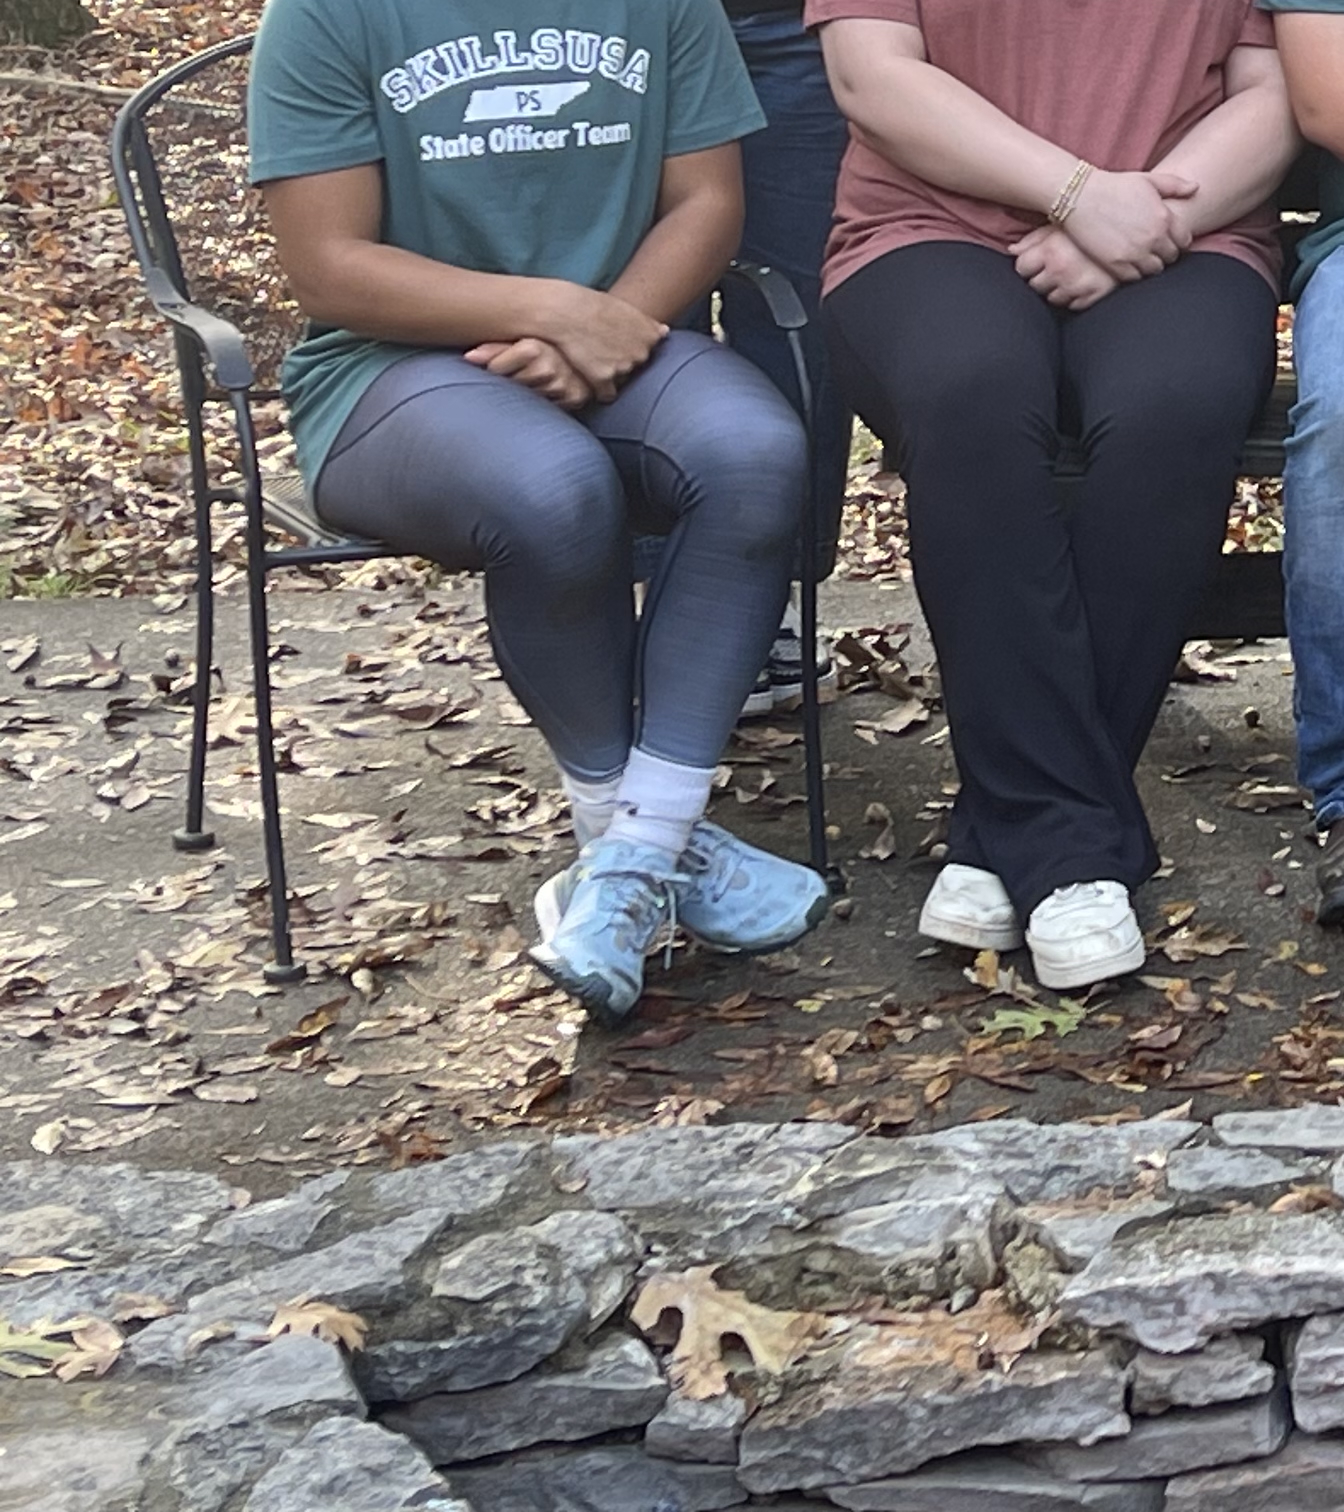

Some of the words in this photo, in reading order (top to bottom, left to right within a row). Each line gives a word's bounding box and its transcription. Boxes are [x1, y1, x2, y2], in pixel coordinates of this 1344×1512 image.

[381, 28, 650, 113] SKILLSUSA
[516, 91, 541, 111] PS
[420, 133, 485, 161] State
[489, 124, 570, 153] Officer
[573, 122, 630, 146] Team
